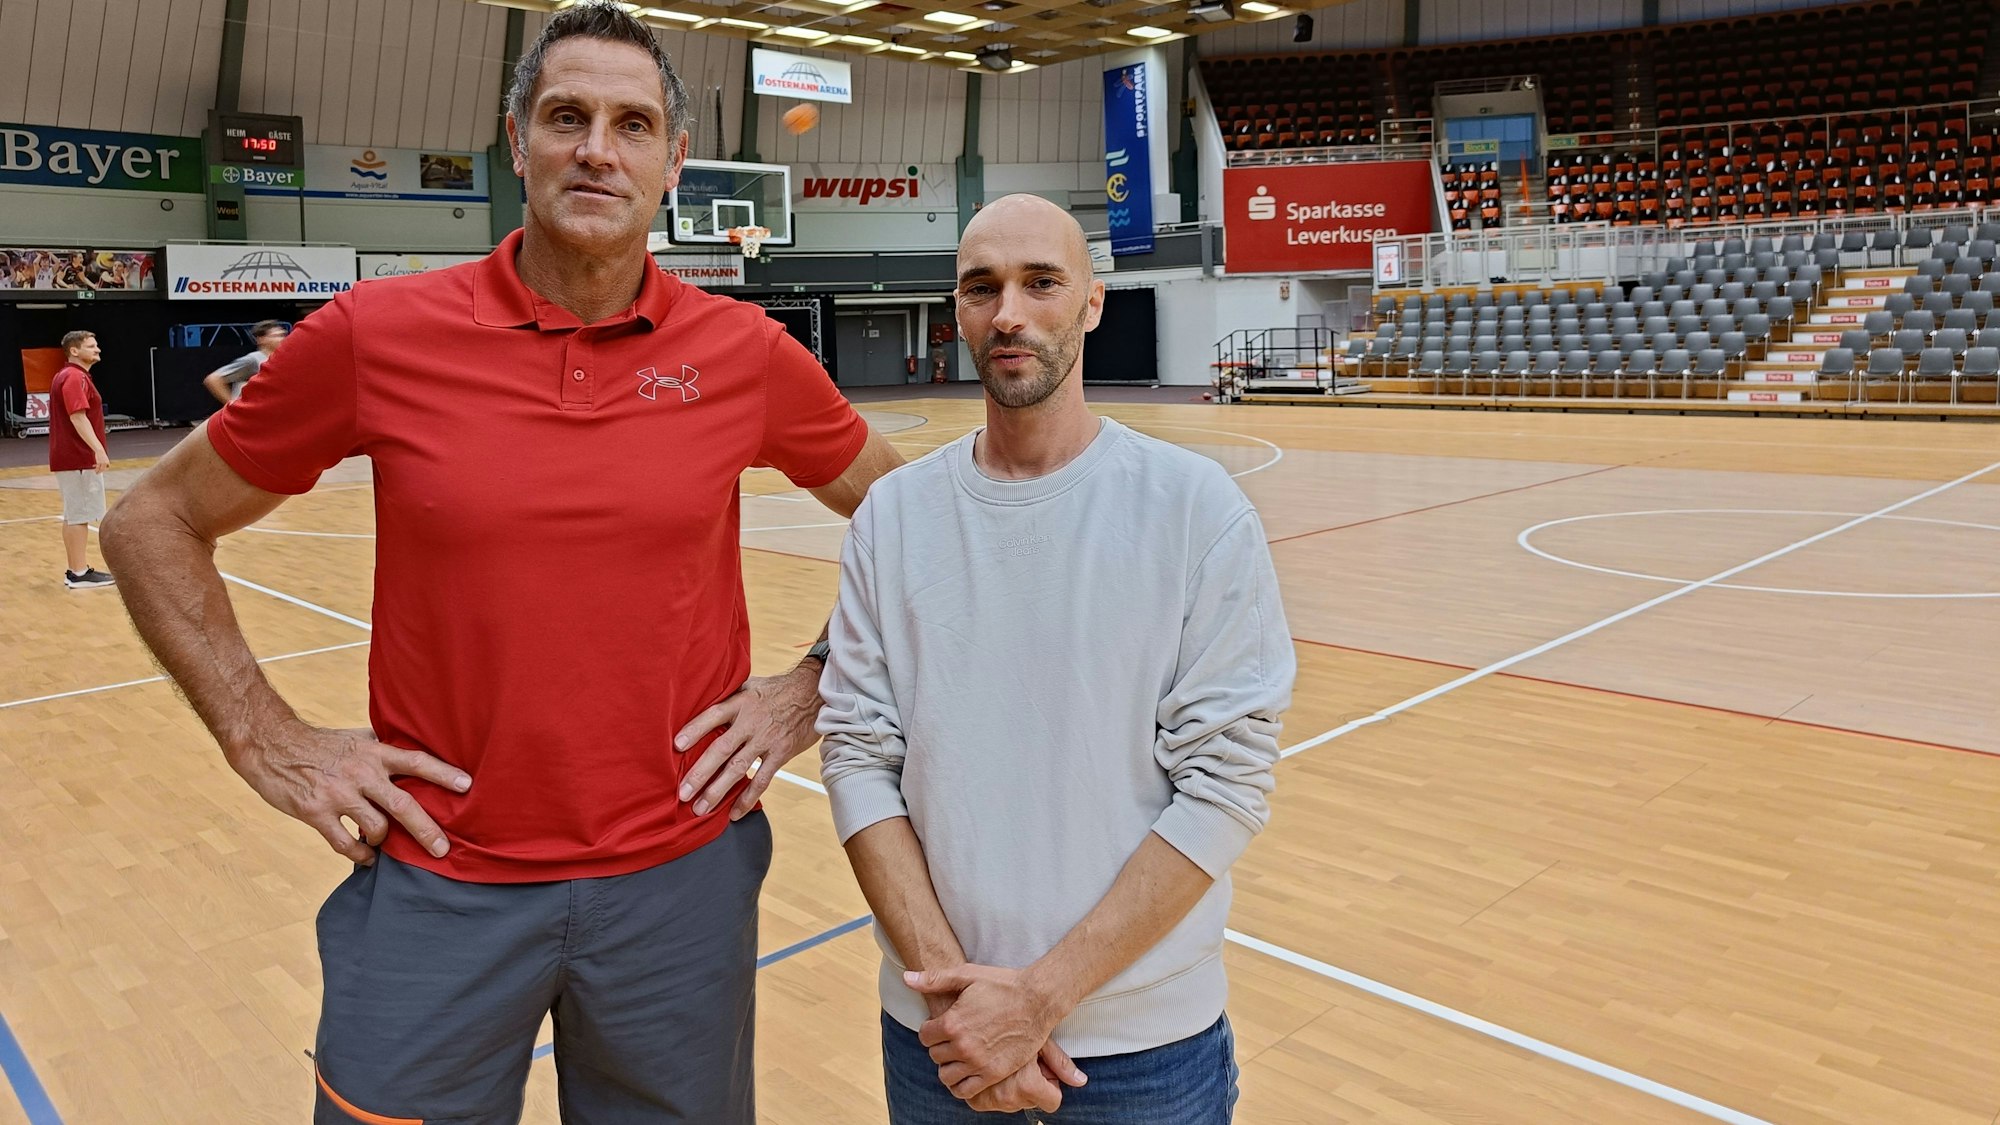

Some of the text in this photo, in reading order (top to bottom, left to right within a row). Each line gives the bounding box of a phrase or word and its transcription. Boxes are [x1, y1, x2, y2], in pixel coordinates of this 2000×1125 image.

[226, 128, 292, 141] HEIM GÄSTE
[0, 128, 180, 185] Bayer
[242, 168, 295, 186] Bayer
[803, 165, 919, 205] wupsi
[216, 206, 239, 216] West
[1286, 201, 1386, 223] Sparkasse
[1287, 226, 1397, 246] Leverkusen
[1384, 262, 1393, 277] 4
